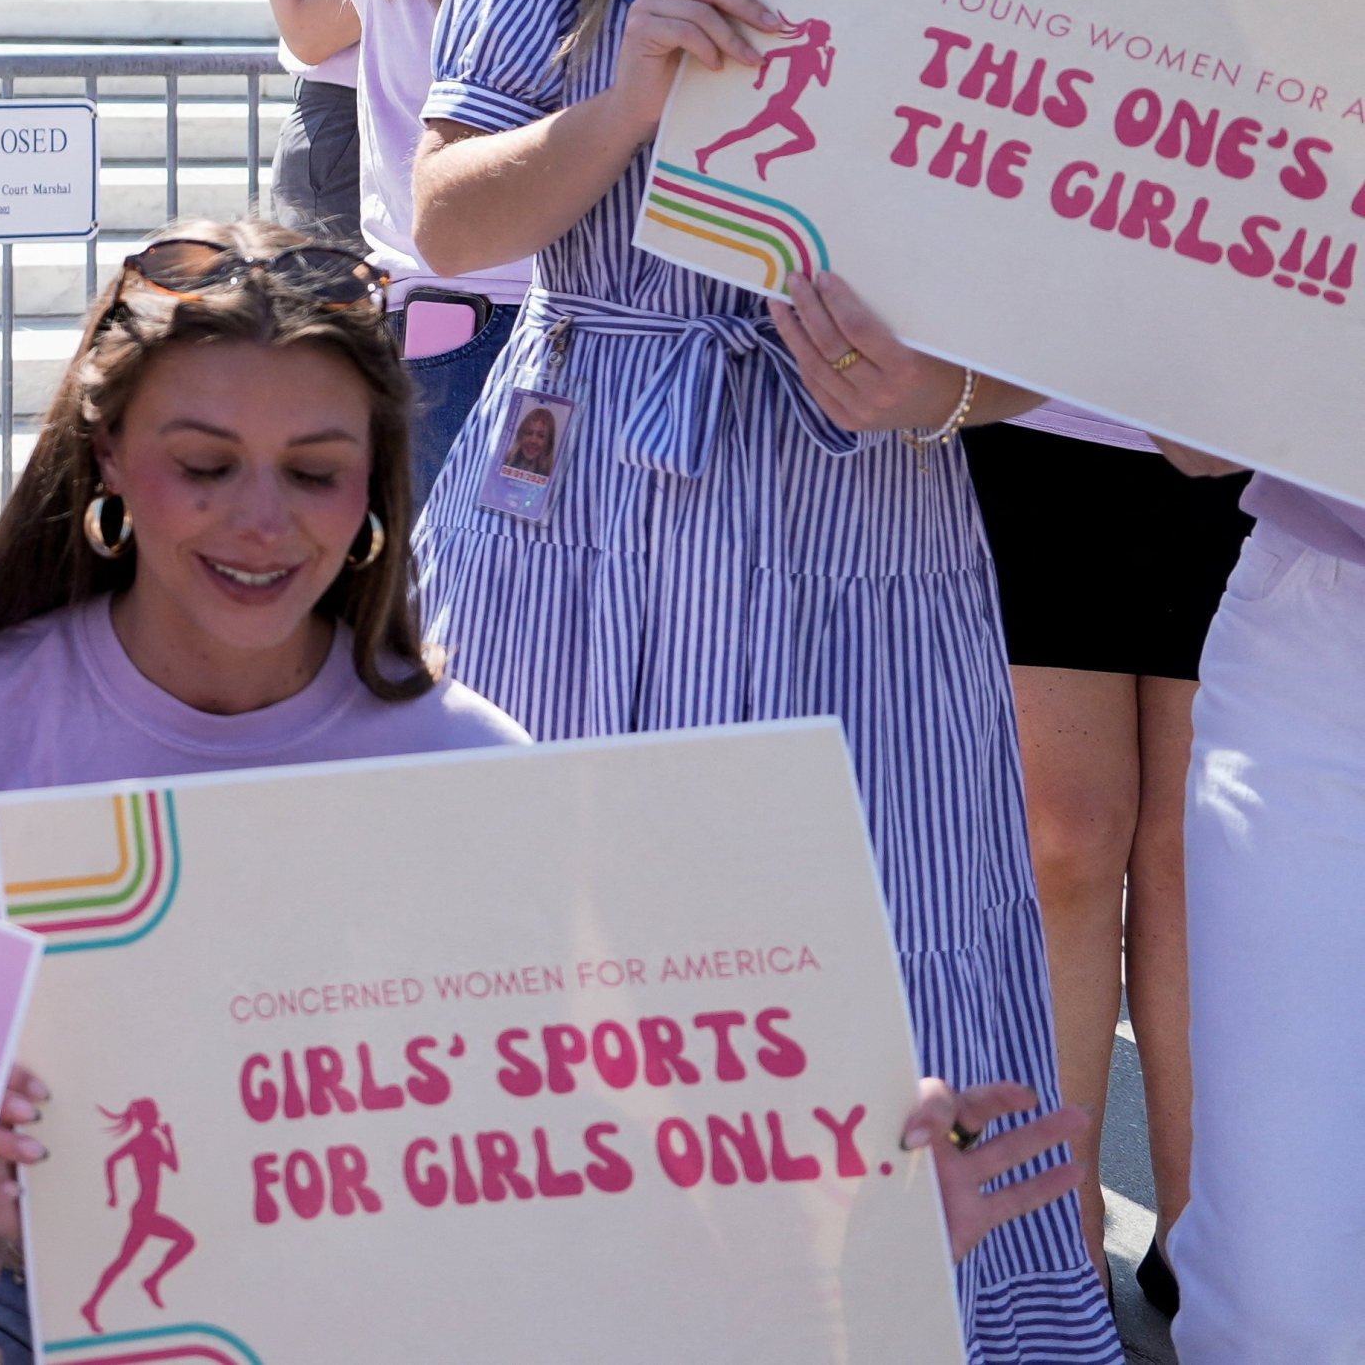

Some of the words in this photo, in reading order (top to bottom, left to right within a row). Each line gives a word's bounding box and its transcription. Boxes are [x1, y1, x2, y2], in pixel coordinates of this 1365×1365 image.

[919, 26, 1095, 129] THIS
[1113, 87, 1334, 201] ONE'S
[1089, 22, 1243, 87] WOMEN
[1256, 70, 1329, 112] FOR
[1, 184, 28, 195] Court
[33, 183, 71, 195] Marshal
[889, 104, 1033, 200] THE
[1050, 160, 1357, 306] GIRLS!!!
[229, 977, 424, 1025] CONCERNED
[435, 965, 564, 1002] WOMEN
[577, 958, 647, 988] FOR
[659, 945, 821, 984] AMERICA
[239, 1032, 465, 1123] GIRLS'
[496, 1007, 807, 1098] SPORTS
[253, 1144, 382, 1225] FOR
[403, 1120, 634, 1208] GIRLS
[655, 1104, 893, 1189] ONLY.
